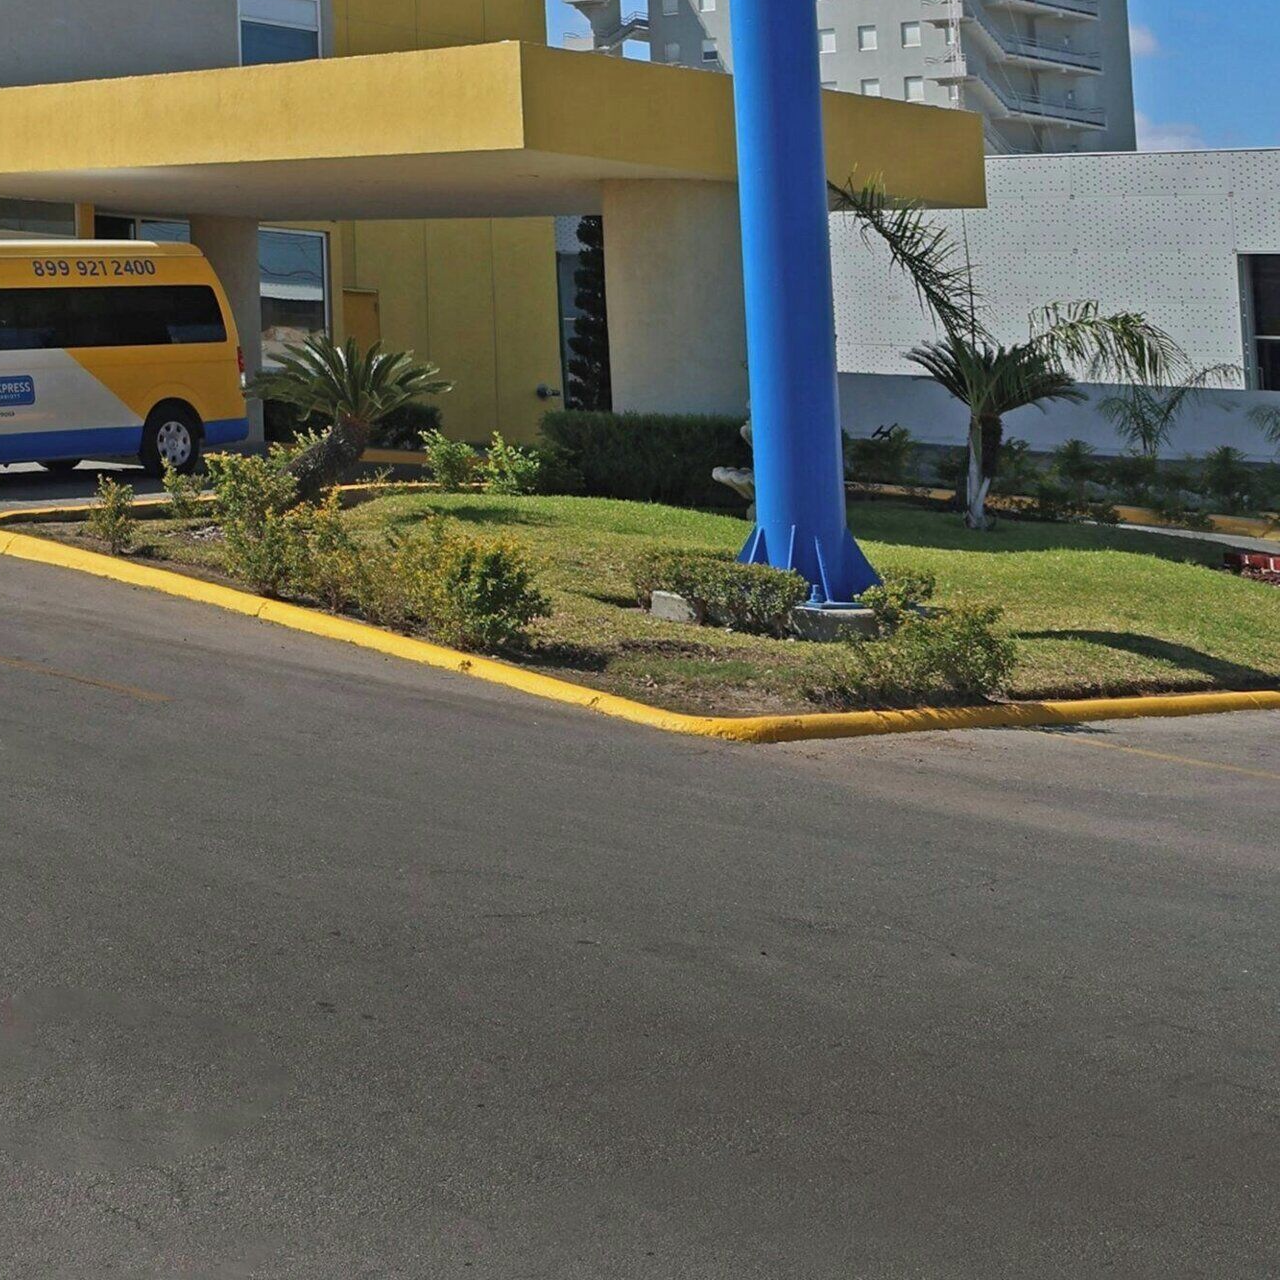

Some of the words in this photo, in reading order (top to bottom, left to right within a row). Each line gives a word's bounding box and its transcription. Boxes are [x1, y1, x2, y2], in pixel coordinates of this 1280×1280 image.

[32, 260, 70, 276] 899
[76, 260, 108, 276] 921
[111, 259, 156, 275] 2400
